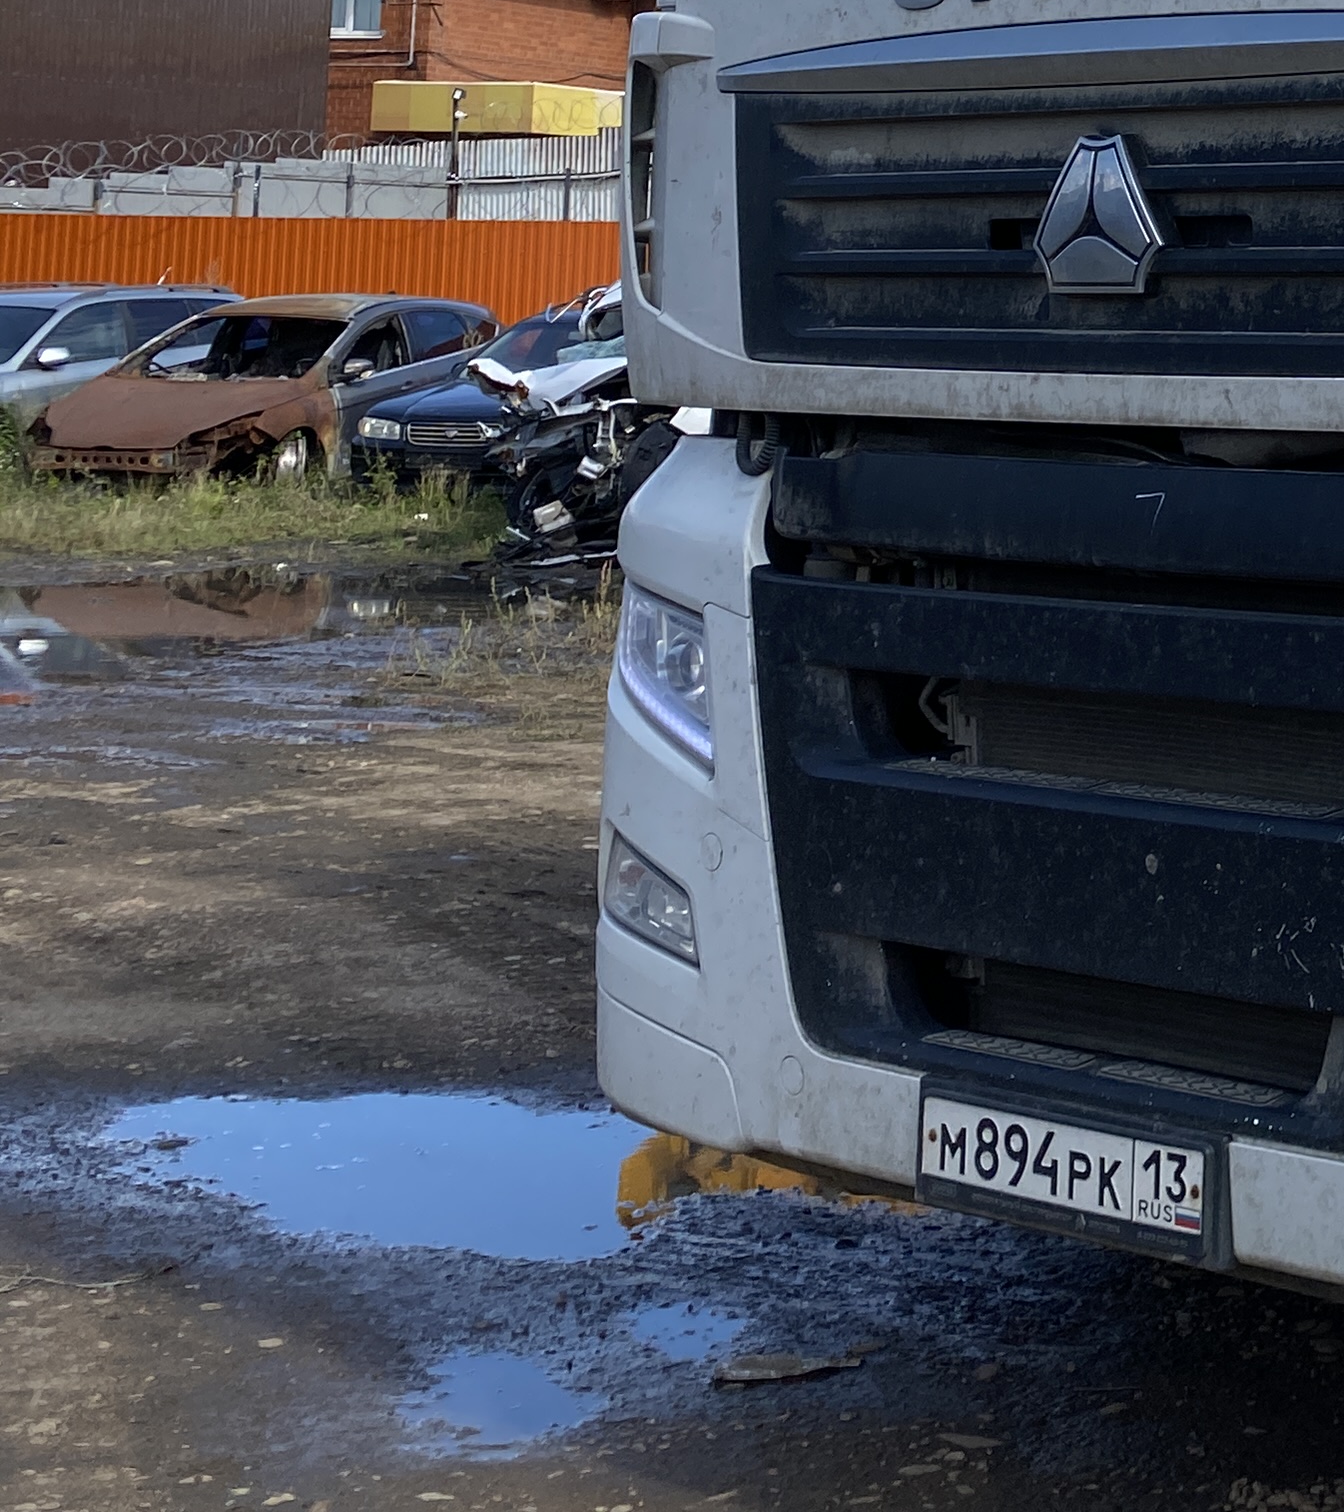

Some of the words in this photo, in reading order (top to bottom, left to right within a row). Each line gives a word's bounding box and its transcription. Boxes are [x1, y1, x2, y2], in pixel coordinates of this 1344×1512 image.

[939, 1117, 1122, 1211] М894РК
[1143, 1149, 1187, 1204] 13
[1138, 1199, 1173, 1223] RUS
